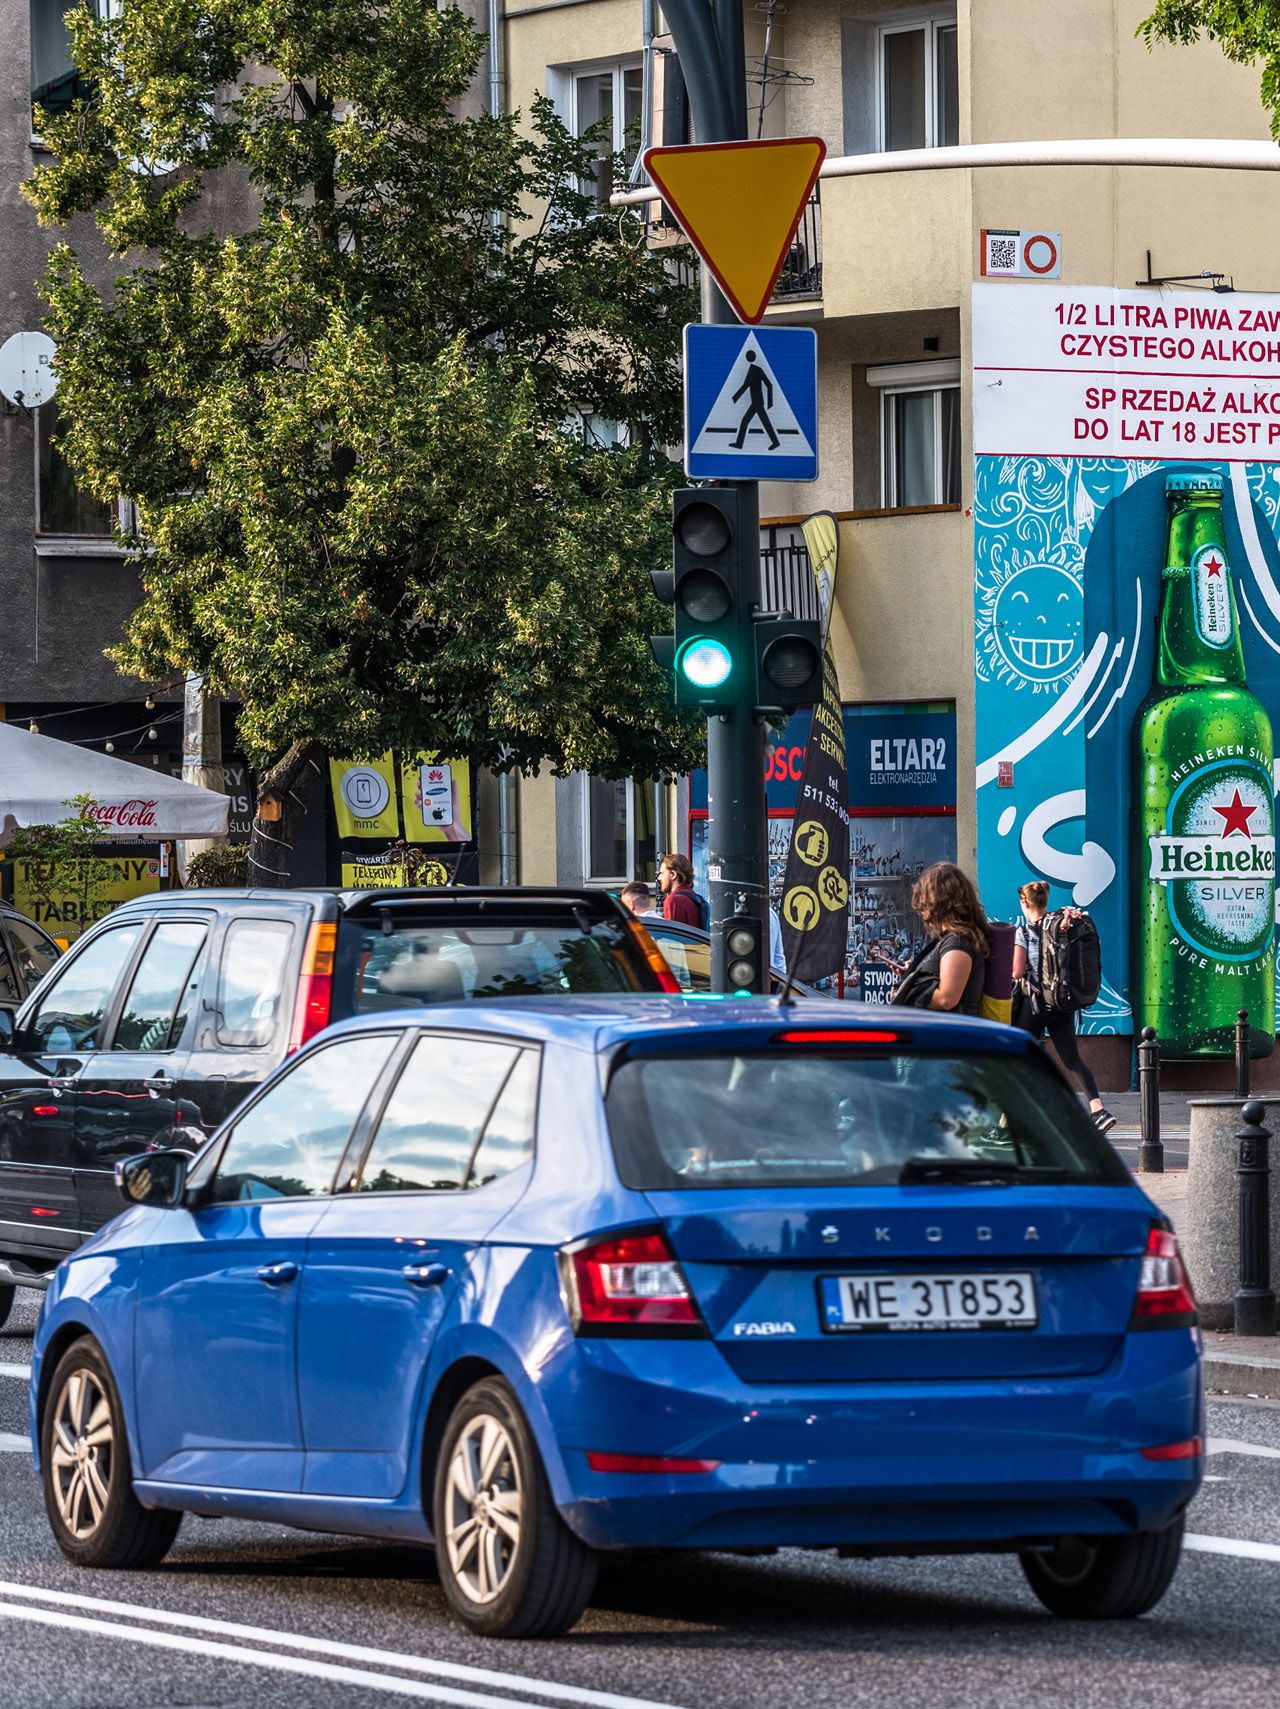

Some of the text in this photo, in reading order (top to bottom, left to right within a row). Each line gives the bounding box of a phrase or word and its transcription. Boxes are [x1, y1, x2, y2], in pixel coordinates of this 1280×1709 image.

[1054, 303, 1087, 325] 1/2
[1174, 307, 1233, 331] PIWA
[1060, 334, 1195, 359] CZYSTEGO
[1074, 418, 1109, 440] DO
[1121, 419, 1164, 442] LAT
[1171, 421, 1197, 443] 18
[1203, 422, 1261, 444] JEST
[1206, 582, 1218, 632] Heineken
[1216, 583, 1227, 633] SILVER
[764, 746, 807, 782] OSC
[870, 737, 946, 770] ELTAR2
[1170, 744, 1244, 782] HEINEKEN
[828, 775, 839, 793] tel.
[869, 771, 938, 787] ELEKTRONARZĘDZIA
[804, 785, 823, 803] 511
[80, 799, 159, 826] Coca-Cola
[353, 818, 379, 829] mmc
[1201, 887, 1265, 900] SILVER
[1170, 937, 1208, 969] PURE
[1214, 963, 1250, 976] MALT
[865, 986, 885, 1005] DAĆ
[827, 1306, 841, 1316] PL
[848, 1279, 1026, 1319] WE 3T853
[733, 1321, 797, 1336] FABIA
